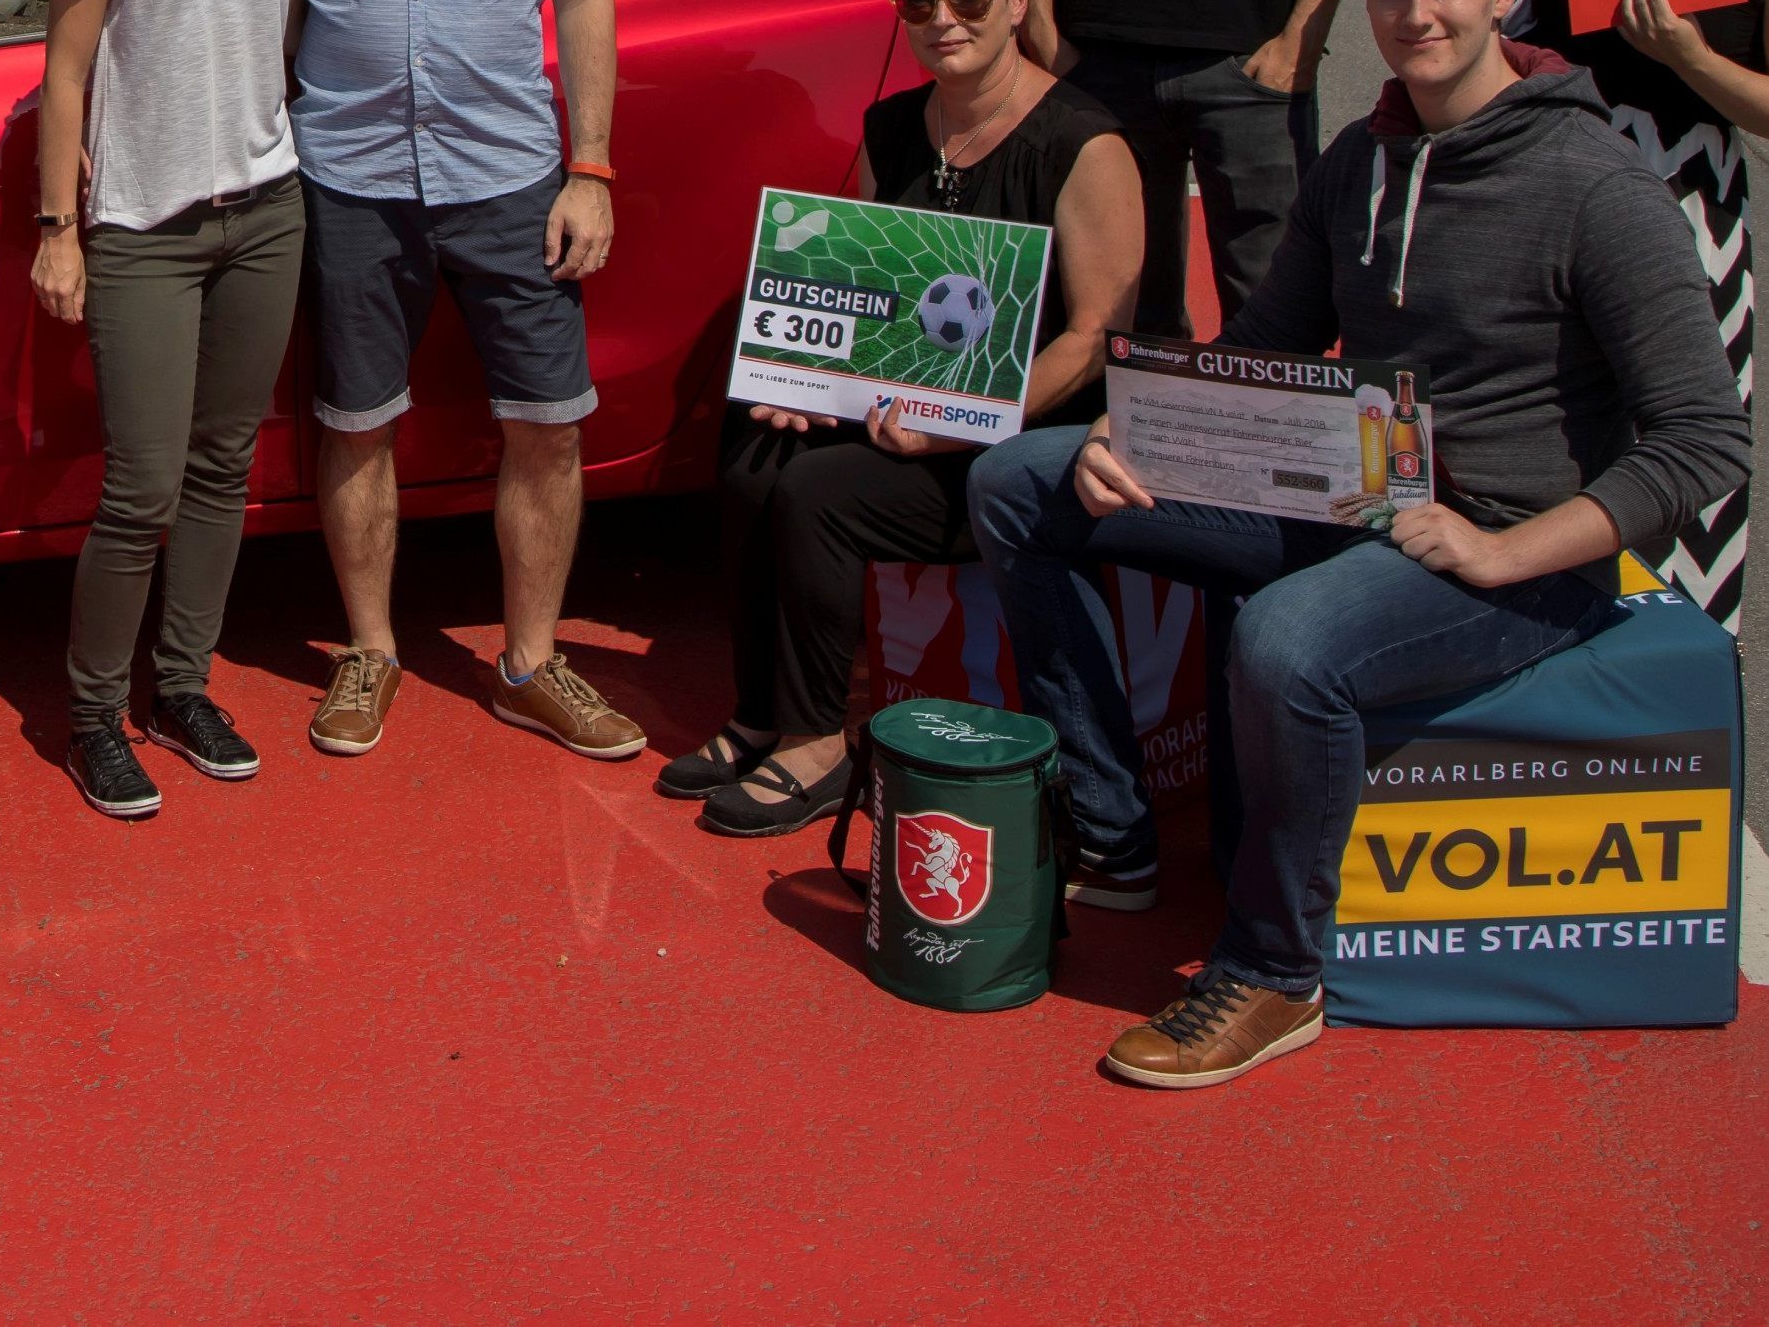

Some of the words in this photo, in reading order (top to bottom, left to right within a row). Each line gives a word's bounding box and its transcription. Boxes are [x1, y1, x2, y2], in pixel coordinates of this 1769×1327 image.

[759, 278, 891, 316] GUTSCHEIN
[753, 309, 777, 339] €
[783, 316, 845, 350] 300
[1130, 342, 1190, 364] Fohrenburger
[749, 372, 764, 380] AUS
[765, 374, 788, 384] LIEBE
[789, 378, 805, 387] ZUM
[807, 381, 830, 391] SPORT
[1197, 351, 1354, 390] GUTSCHEIN
[901, 399, 1001, 429] NTERSPORT
[1129, 396, 1143, 406] Für
[1254, 414, 1279, 425] Datum
[1303, 418, 1326, 430] 2018
[1149, 417, 1172, 429] einen
[1174, 421, 1230, 437] Jahresvorrat
[1295, 436, 1313, 447] Bier
[1149, 432, 1170, 444] nach
[1172, 434, 1197, 447] Wahl
[1147, 448, 1183, 462] Brauerei
[1366, 759, 1569, 786] VORARLBERG
[1585, 755, 1703, 777] ONLINE
[1365, 819, 1702, 894] VOL.AT
[1336, 927, 1466, 960] MEINE
[1480, 917, 1727, 953] STARTSEITE
